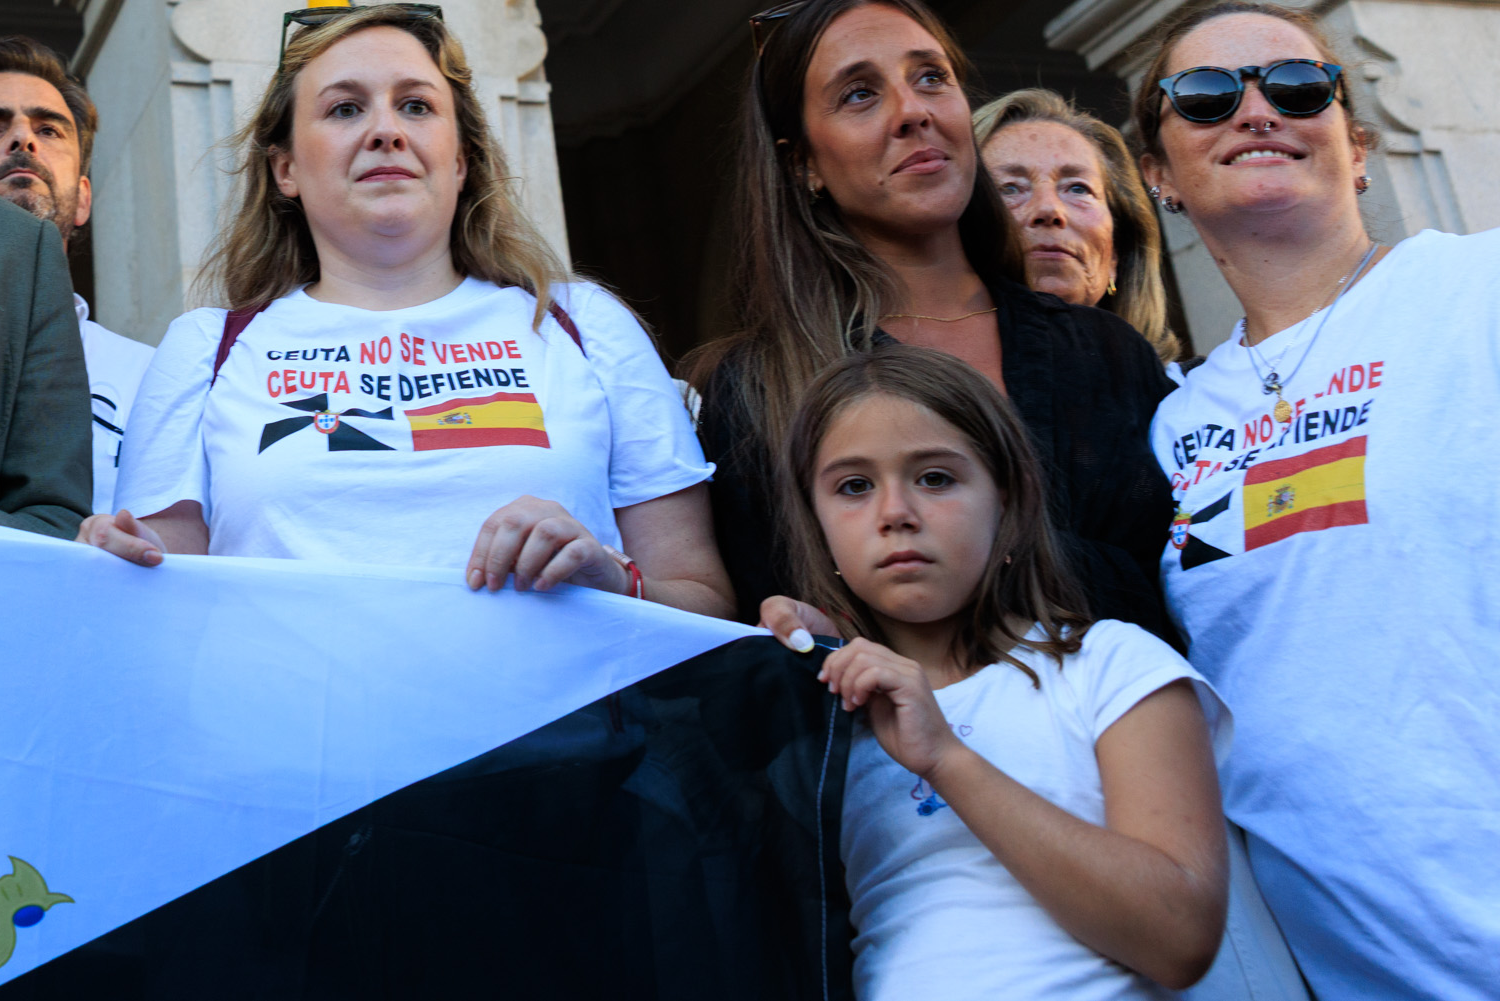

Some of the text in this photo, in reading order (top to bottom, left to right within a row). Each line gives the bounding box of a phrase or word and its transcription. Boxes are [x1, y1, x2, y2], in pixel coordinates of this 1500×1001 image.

[266, 332, 522, 366] CEUTA NO SE VENDE
[266, 368, 530, 402] CEUTA SE DEFIENDE
[1242, 414, 1273, 449] NO
[1314, 361, 1384, 399] NDE
